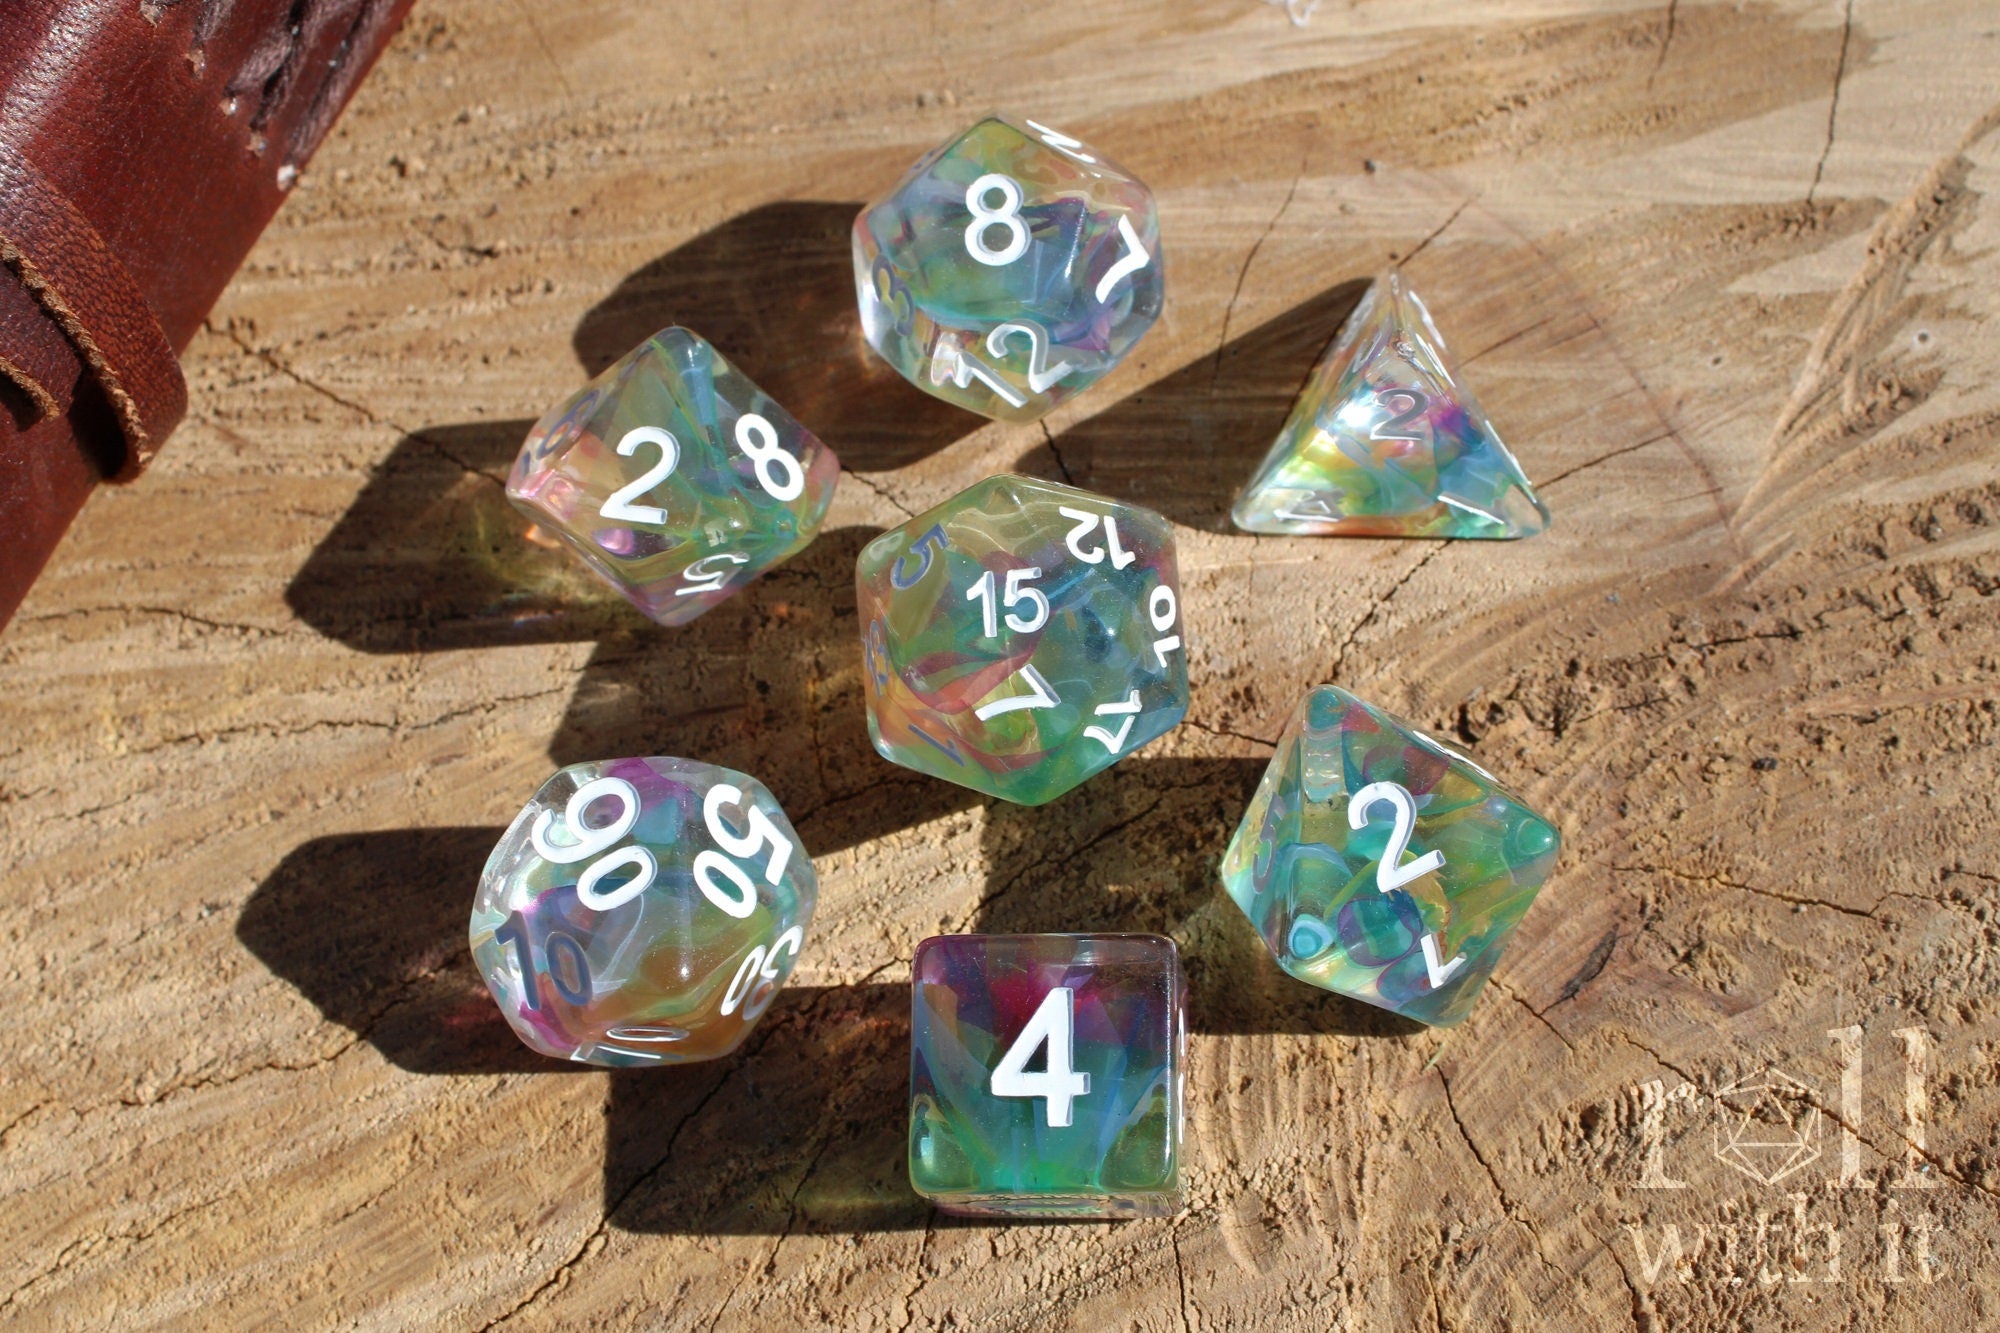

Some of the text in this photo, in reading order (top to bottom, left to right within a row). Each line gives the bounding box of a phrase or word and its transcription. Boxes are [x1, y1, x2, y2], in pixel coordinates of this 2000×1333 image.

[964, 173, 1032, 266] 8
[1095, 214, 1150, 304] 7
[930, 319, 1074, 408] 12
[735, 413, 804, 501] 8
[1372, 388, 1432, 440] 2
[600, 426, 680, 525] 2
[890, 523, 949, 591] 5
[1059, 505, 1136, 571] 12
[966, 566, 1050, 638] 15
[1150, 584, 1181, 669] 10
[975, 663, 1061, 722] 7
[1083, 689, 1143, 755] 17
[531, 776, 658, 912] 90
[693, 783, 793, 919] 50
[1348, 781, 1447, 893] 2
[495, 910, 593, 1011] 10
[990, 986, 1092, 1128] 4
